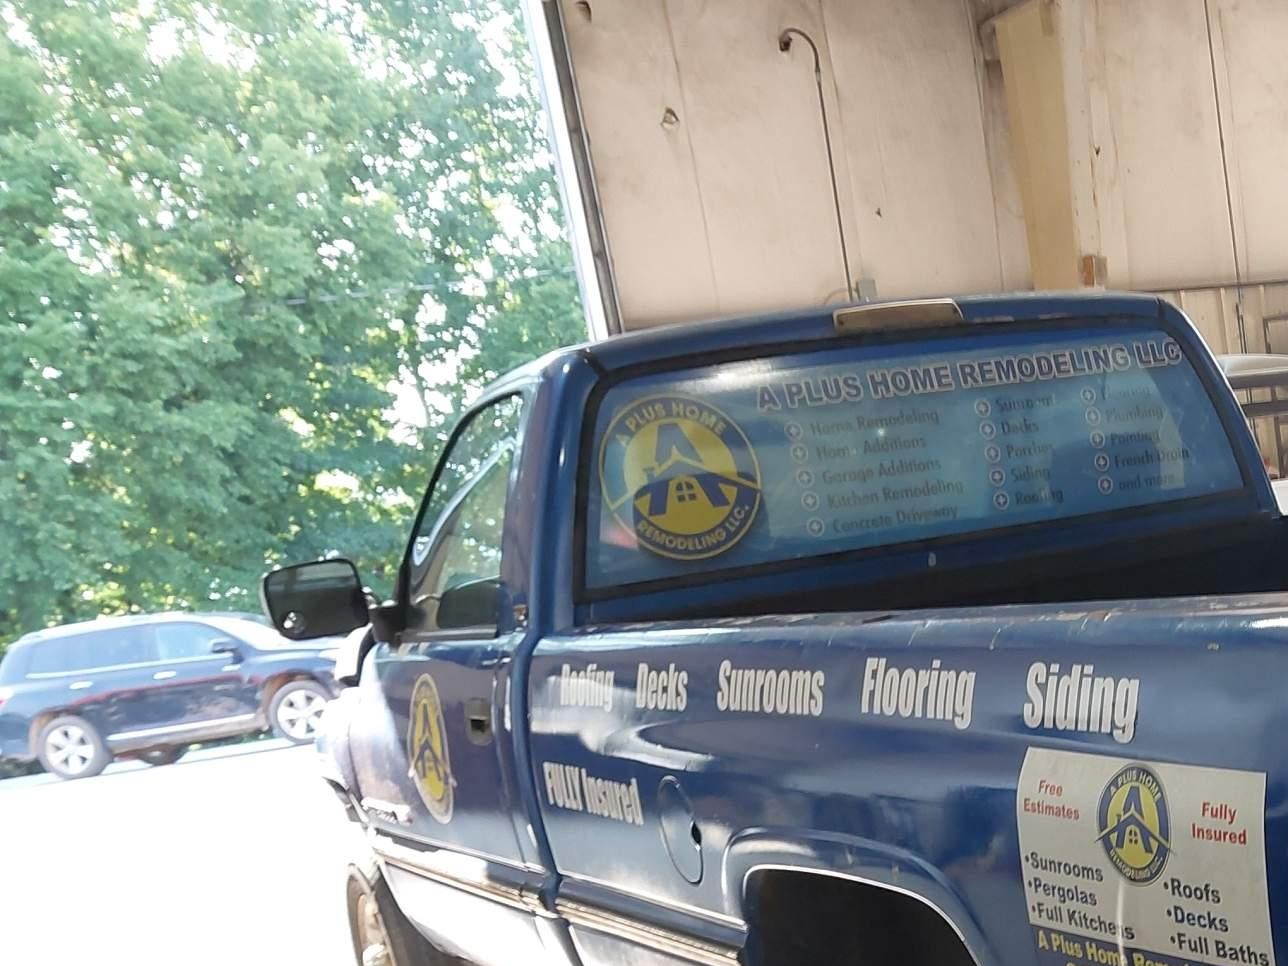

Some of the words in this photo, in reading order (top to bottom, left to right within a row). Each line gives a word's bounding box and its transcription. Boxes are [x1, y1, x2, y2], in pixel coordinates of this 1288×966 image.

[757, 385, 781, 411] A
[784, 374, 864, 408] PLUS
[866, 363, 954, 399] HOME
[957, 344, 1131, 388] REMODELING
[1132, 337, 1184, 368] LLC
[616, 433, 630, 447] A
[625, 403, 667, 432] PLUS
[672, 401, 727, 435] HOME
[878, 458, 942, 478] Additions
[882, 479, 964, 500] Remodeling
[638, 520, 727, 550] REMODELING
[560, 663, 615, 713] Roofing
[635, 663, 688, 712] Decks
[717, 659, 825, 717] Sunrooms
[861, 657, 976, 730] Flooring
[1023, 662, 1140, 744] Siding
[1038, 780, 1064, 797] Free
[1023, 798, 1080, 821] Estimates
[1201, 802, 1237, 825] Fully
[1191, 823, 1248, 845] Insured
[1038, 930, 1049, 950] A
[1051, 933, 1083, 960] Plus
[1215, 940, 1270, 966] Baths
